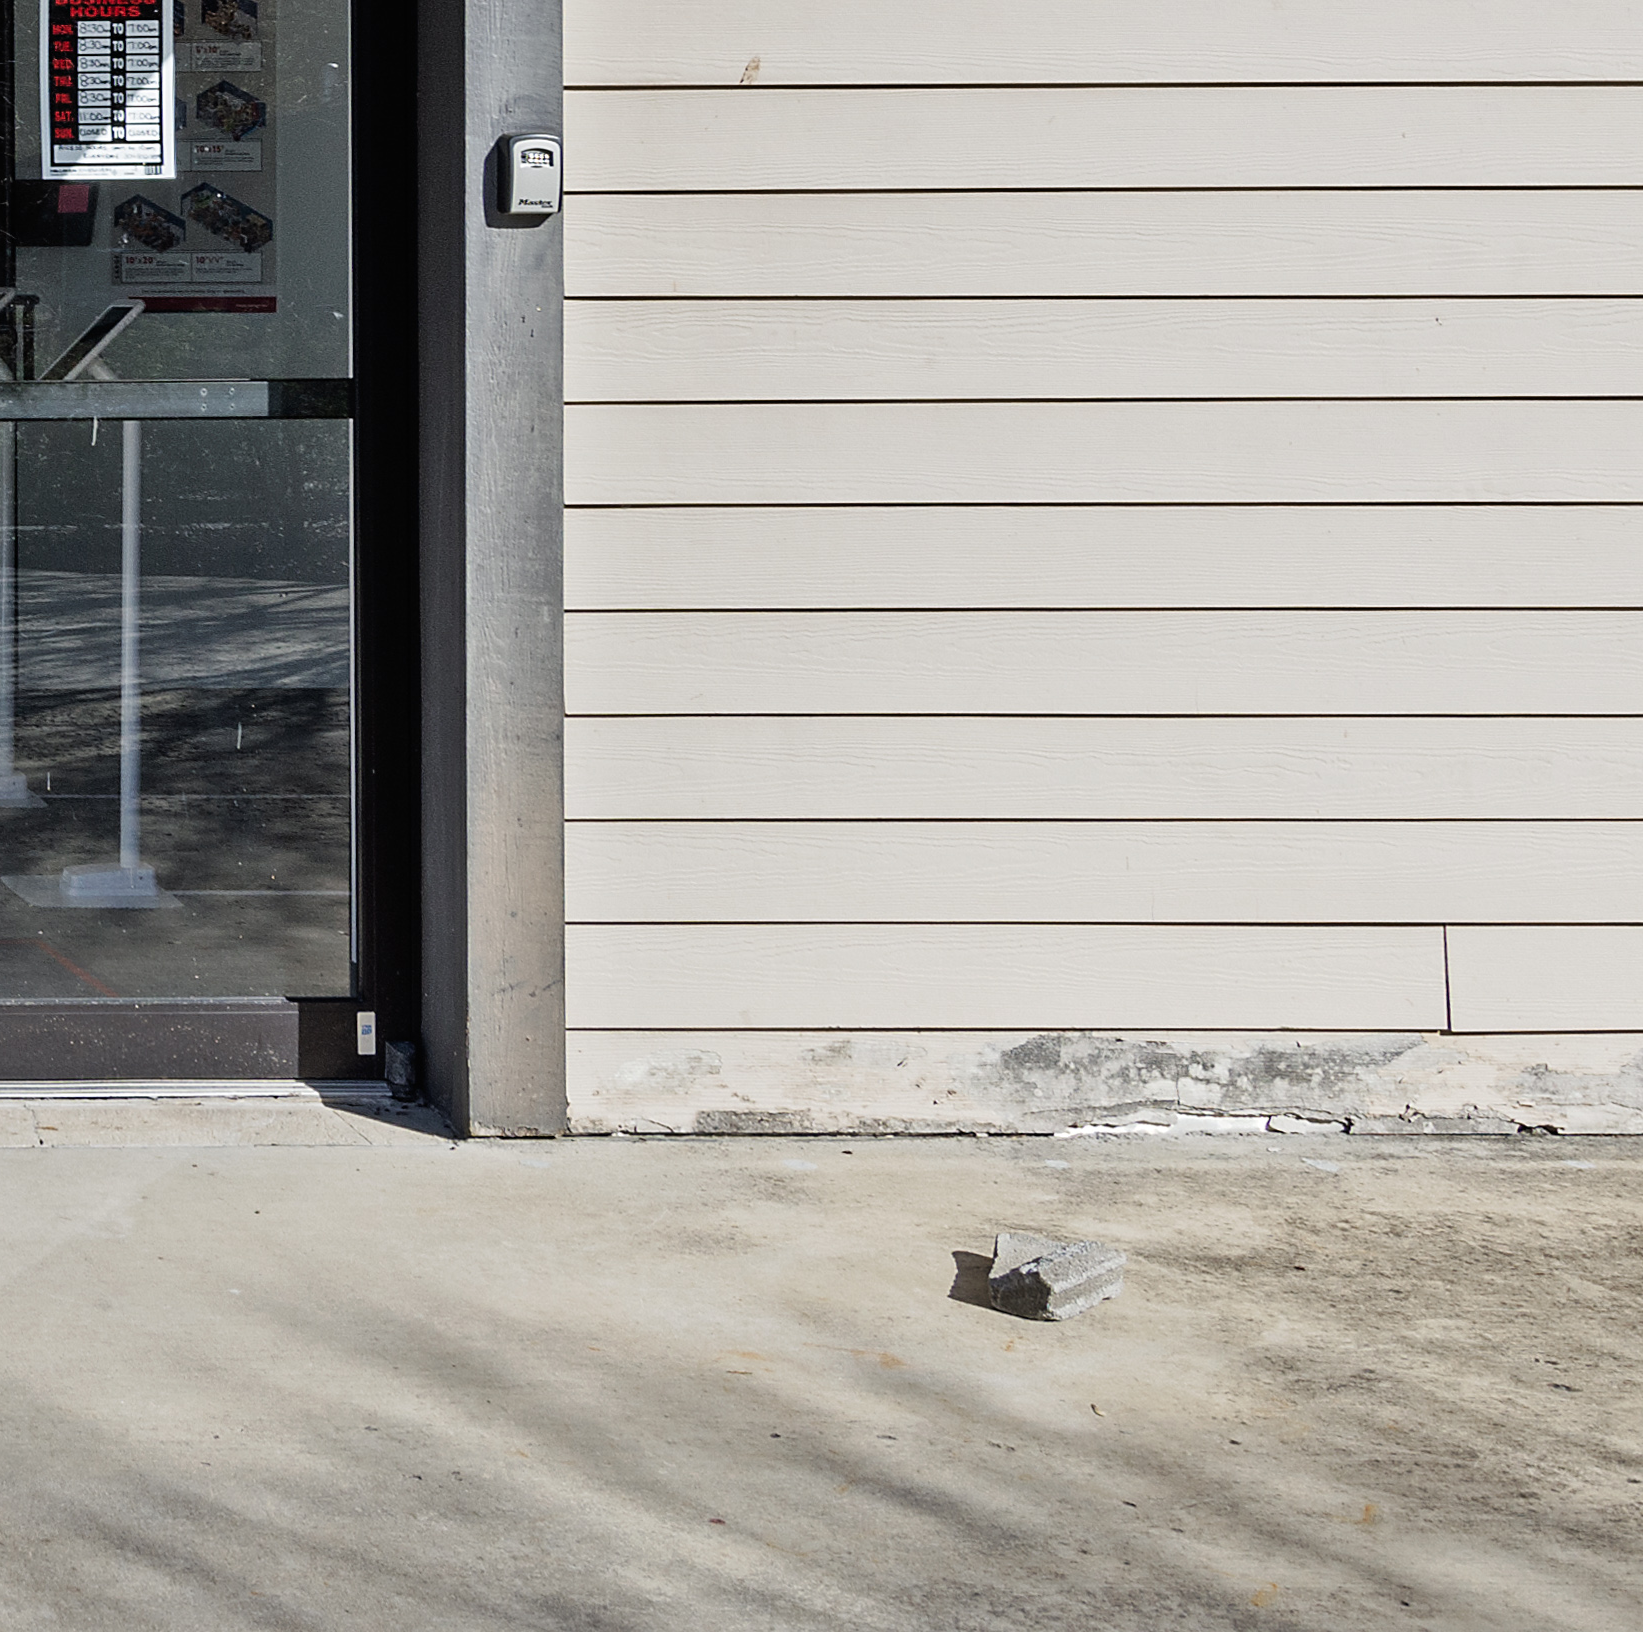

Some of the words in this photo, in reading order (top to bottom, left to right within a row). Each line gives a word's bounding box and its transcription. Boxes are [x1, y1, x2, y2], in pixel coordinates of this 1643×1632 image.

[70, 6, 141, 17] HOURS
[112, 23, 124, 35] TO
[112, 40, 124, 52] TO
[112, 58, 124, 69] TO
[112, 75, 124, 87] TO
[112, 92, 124, 104] TO
[55, 111, 74, 122] SAT.
[112, 110, 124, 122] TO
[112, 126, 125, 139] TO
